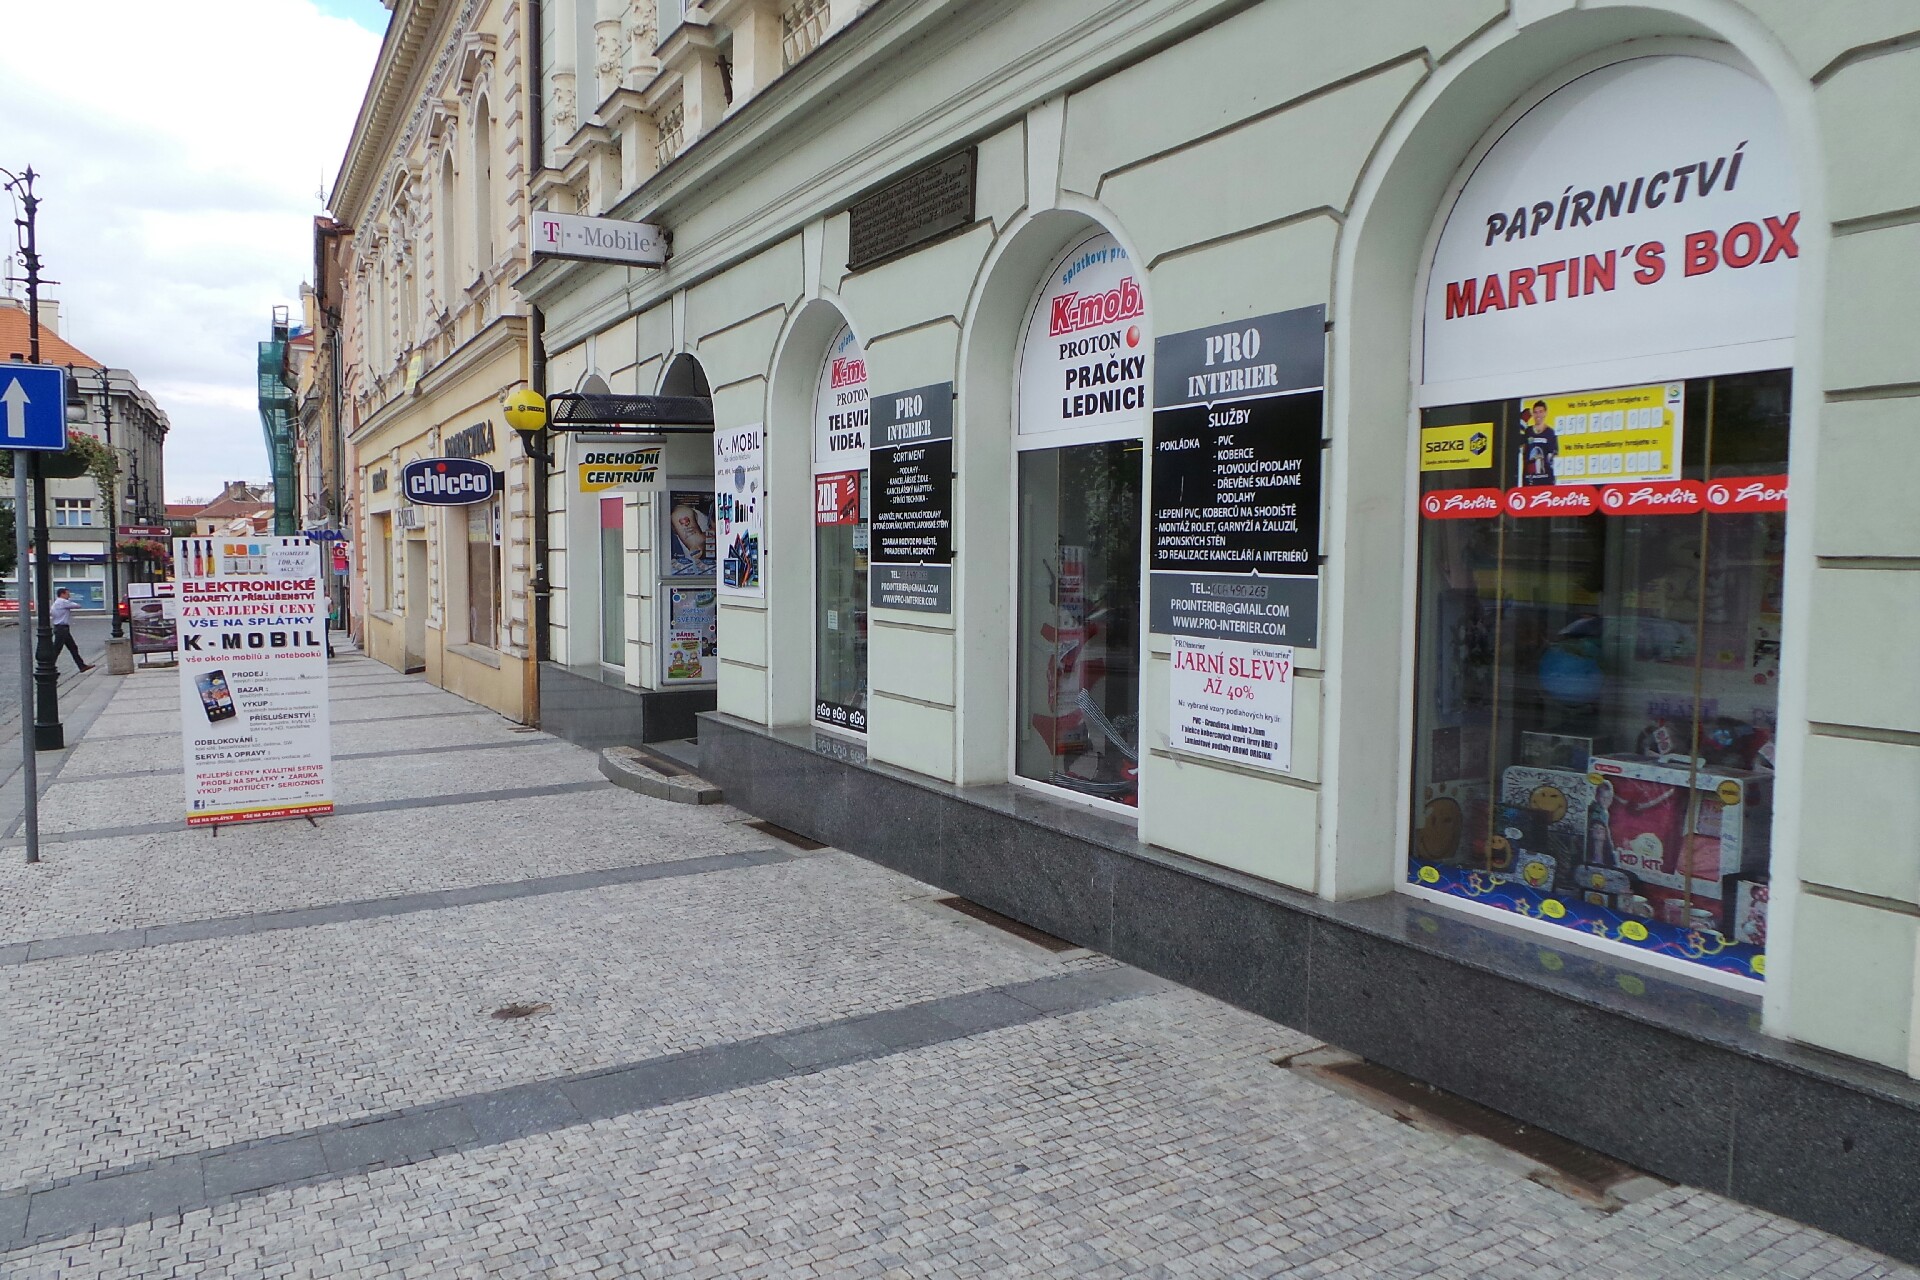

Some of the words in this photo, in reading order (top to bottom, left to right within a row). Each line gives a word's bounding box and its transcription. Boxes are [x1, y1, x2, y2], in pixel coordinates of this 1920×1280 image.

[1485, 140, 1749, 247] PAPÍRNICTVÍ
[1684, 211, 1801, 278] BOX
[1059, 330, 1121, 360] PROTON
[1205, 327, 1261, 366] PRO
[1065, 352, 1145, 390] PRAČKY
[1187, 363, 1279, 397] INTERIER
[895, 394, 923, 419] PRO
[1208, 407, 1251, 428] SLUŽBY
[887, 420, 931, 441] INTERIER
[829, 432, 865, 451] VIDEA,
[1159, 437, 1200, 451] POKLÁDKA
[1217, 434, 1234, 446] PVC
[584, 450, 661, 465] OBCHODNÍ
[1217, 448, 1254, 461] KOBERCE
[1217, 460, 1259, 475] PLOVOUCÍ
[1259, 459, 1302, 473] PODLAHY
[411, 464, 488, 496] chicco
[586, 471, 655, 484] CENTRUM
[1217, 474, 1254, 489] DŘEVĚNÉ
[1255, 473, 1302, 487] SKLÁDANÉ
[817, 483, 838, 511] ZDE
[1216, 492, 1256, 503] PODLAHY
[1158, 507, 1184, 519] LEPENÍ
[1184, 508, 1201, 519] PVC,
[1202, 505, 1239, 518] KOBERCŮ
[1240, 507, 1253, 517] NA
[1158, 520, 1190, 532] MONTÁŽ
[1191, 522, 1216, 534] ROLET,
[1217, 519, 1253, 532] GARNYŽÍ
[1254, 521, 1261, 531] A
[1157, 534, 1205, 546] JAPONSKÝCH
[1206, 534, 1226, 546] STĚN
[1158, 550, 1168, 560] 3D
[1169, 550, 1209, 560] REALIZACE
[1255, 551, 1262, 561] A
[183, 578, 315, 593] ELEKTRONICKÉ
[183, 594, 232, 603] CIGARETY
[241, 592, 315, 602] PŘÍSLUŠENSTVÍ
[183, 606, 201, 616] ZA
[207, 603, 274, 616] NEJLEPŠÍ
[280, 603, 316, 614] CENY
[1170, 598, 1290, 617] PROINTERIER@GMAIL.COM
[189, 618, 218, 627] VŠE
[223, 617, 243, 627] NA
[248, 616, 314, 626] SPLÁTKY
[1172, 615, 1286, 636] WWW.PRO-INTERIER.COM
[232, 651, 262, 660] mobilů
[274, 650, 322, 659] notebooků
[231, 670, 264, 678] PRODEJ
[1174, 651, 1224, 674] JARNÍ
[1229, 657, 1289, 683] SLEVY
[237, 686, 264, 694] BAZAR
[1203, 676, 1222, 695] AŽ
[1227, 685, 1254, 700] 40%
[249, 712, 311, 721] PŘÍSLUŠENSTVÍ
[832, 706, 847, 720] eGo
[850, 710, 865, 726] eGo
[194, 735, 253, 746] ODBLOKOVÁNÍ
[195, 752, 225, 760] SERVIS
[234, 750, 266, 758] OPRAVY
[196, 771, 232, 779] NEJLEPŠÍ
[234, 769, 254, 777] CENY
[262, 766, 295, 774] KVALITNÍ
[297, 764, 323, 772] SERVIS
[201, 779, 231, 787] PRODEJ
[245, 775, 278, 783] SPLÁTKY
